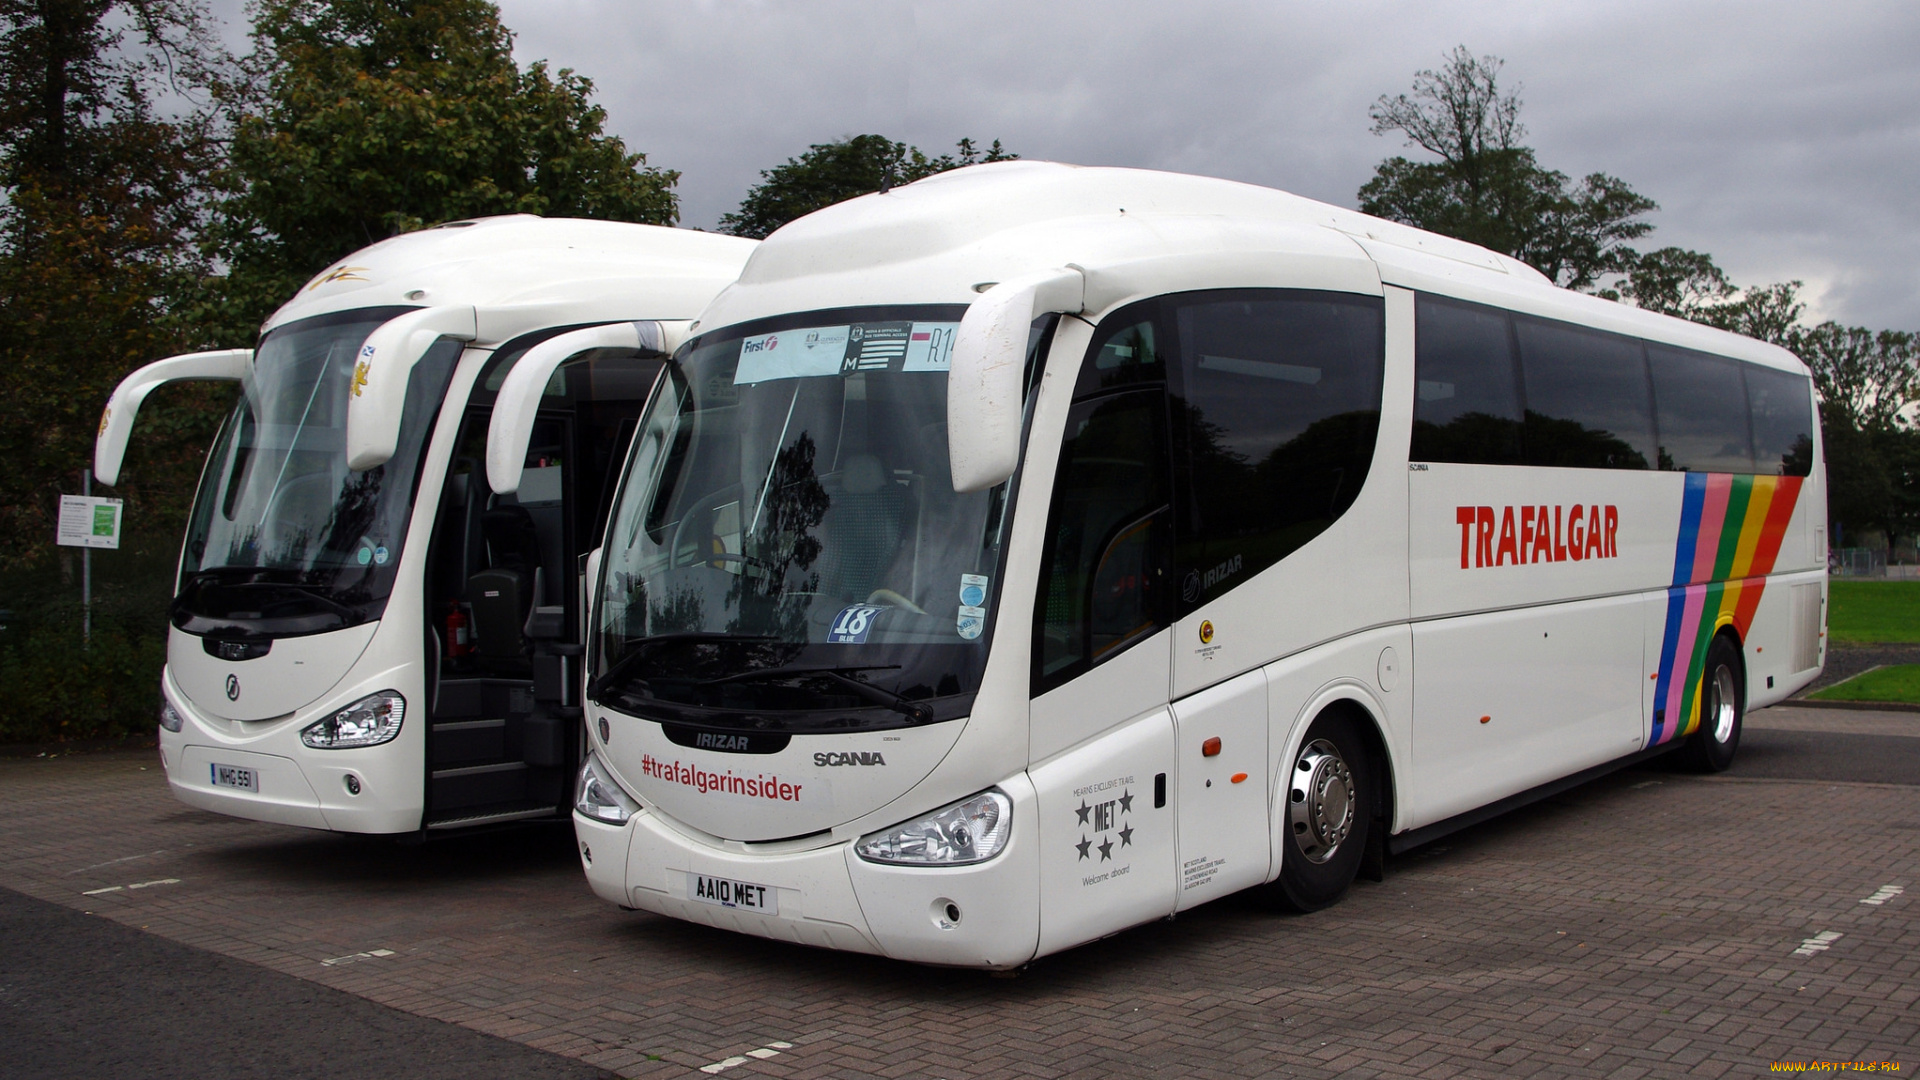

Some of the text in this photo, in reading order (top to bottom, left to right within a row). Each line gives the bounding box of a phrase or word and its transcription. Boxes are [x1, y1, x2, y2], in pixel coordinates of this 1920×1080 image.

[744, 340, 765, 353] First
[927, 328, 956, 363] R1
[843, 357, 858, 371] M
[1409, 464, 1429, 472] SCANIA
[1456, 504, 1618, 570] TRAFALGAR
[1203, 554, 1243, 590] IRIZAR
[834, 608, 876, 635] 18
[696, 732, 749, 750] IRIZAR
[813, 752, 887, 767] SCANIA
[219, 767, 236, 785] NHG
[642, 753, 803, 802] #trafalgarinsider
[1073, 775, 1135, 797] MEARNS EXCLUSIVE TRAVEL
[1094, 800, 1116, 833] MET
[1082, 864, 1130, 887] Welcome aboard
[734, 882, 766, 908] MET
